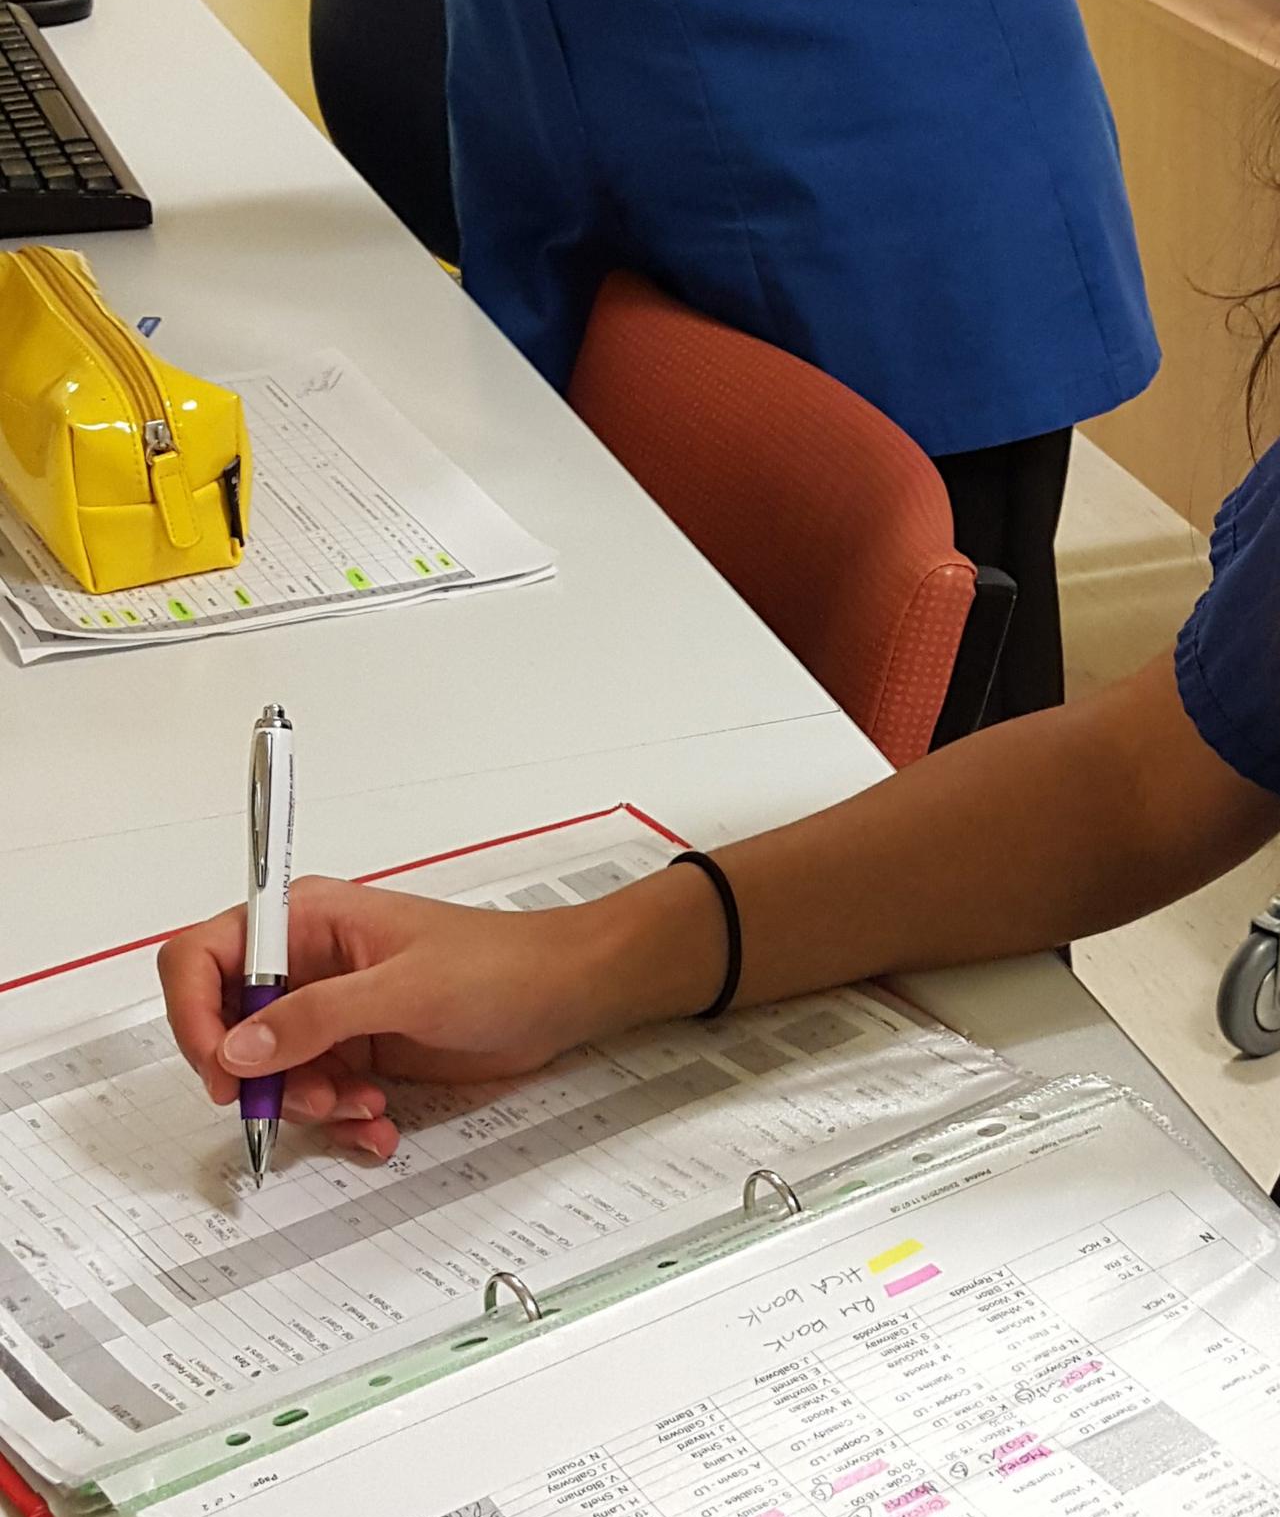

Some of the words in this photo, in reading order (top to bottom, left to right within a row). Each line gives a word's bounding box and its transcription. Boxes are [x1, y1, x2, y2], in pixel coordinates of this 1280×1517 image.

[811, 1268, 862, 1294] HCA
[950, 1277, 993, 1296] Reynolds
[978, 1296, 1011, 1312] Woods
[763, 1319, 827, 1352] bank
[853, 1319, 898, 1340] Reynolds
[865, 1328, 909, 1349] Galloway
[754, 1363, 799, 1385] Galloway
[771, 1374, 808, 1393] Barnett
[774, 1383, 818, 1405] Bloxham
[656, 1410, 694, 1430] Barnett
[801, 1406, 837, 1423] Woods
[659, 1420, 705, 1443] Galloway
[677, 1431, 715, 1451] Havard
[691, 1442, 722, 1458] Shefa
[833, 1435, 870, 1455] Cooper
[547, 1459, 586, 1479] Poulter
[703, 1453, 734, 1469] Laing
[548, 1466, 597, 1493] Galloway
[717, 1469, 748, 1484] Gavin
[557, 1480, 605, 1504] Bloxham
[581, 1492, 613, 1508] Shefa
